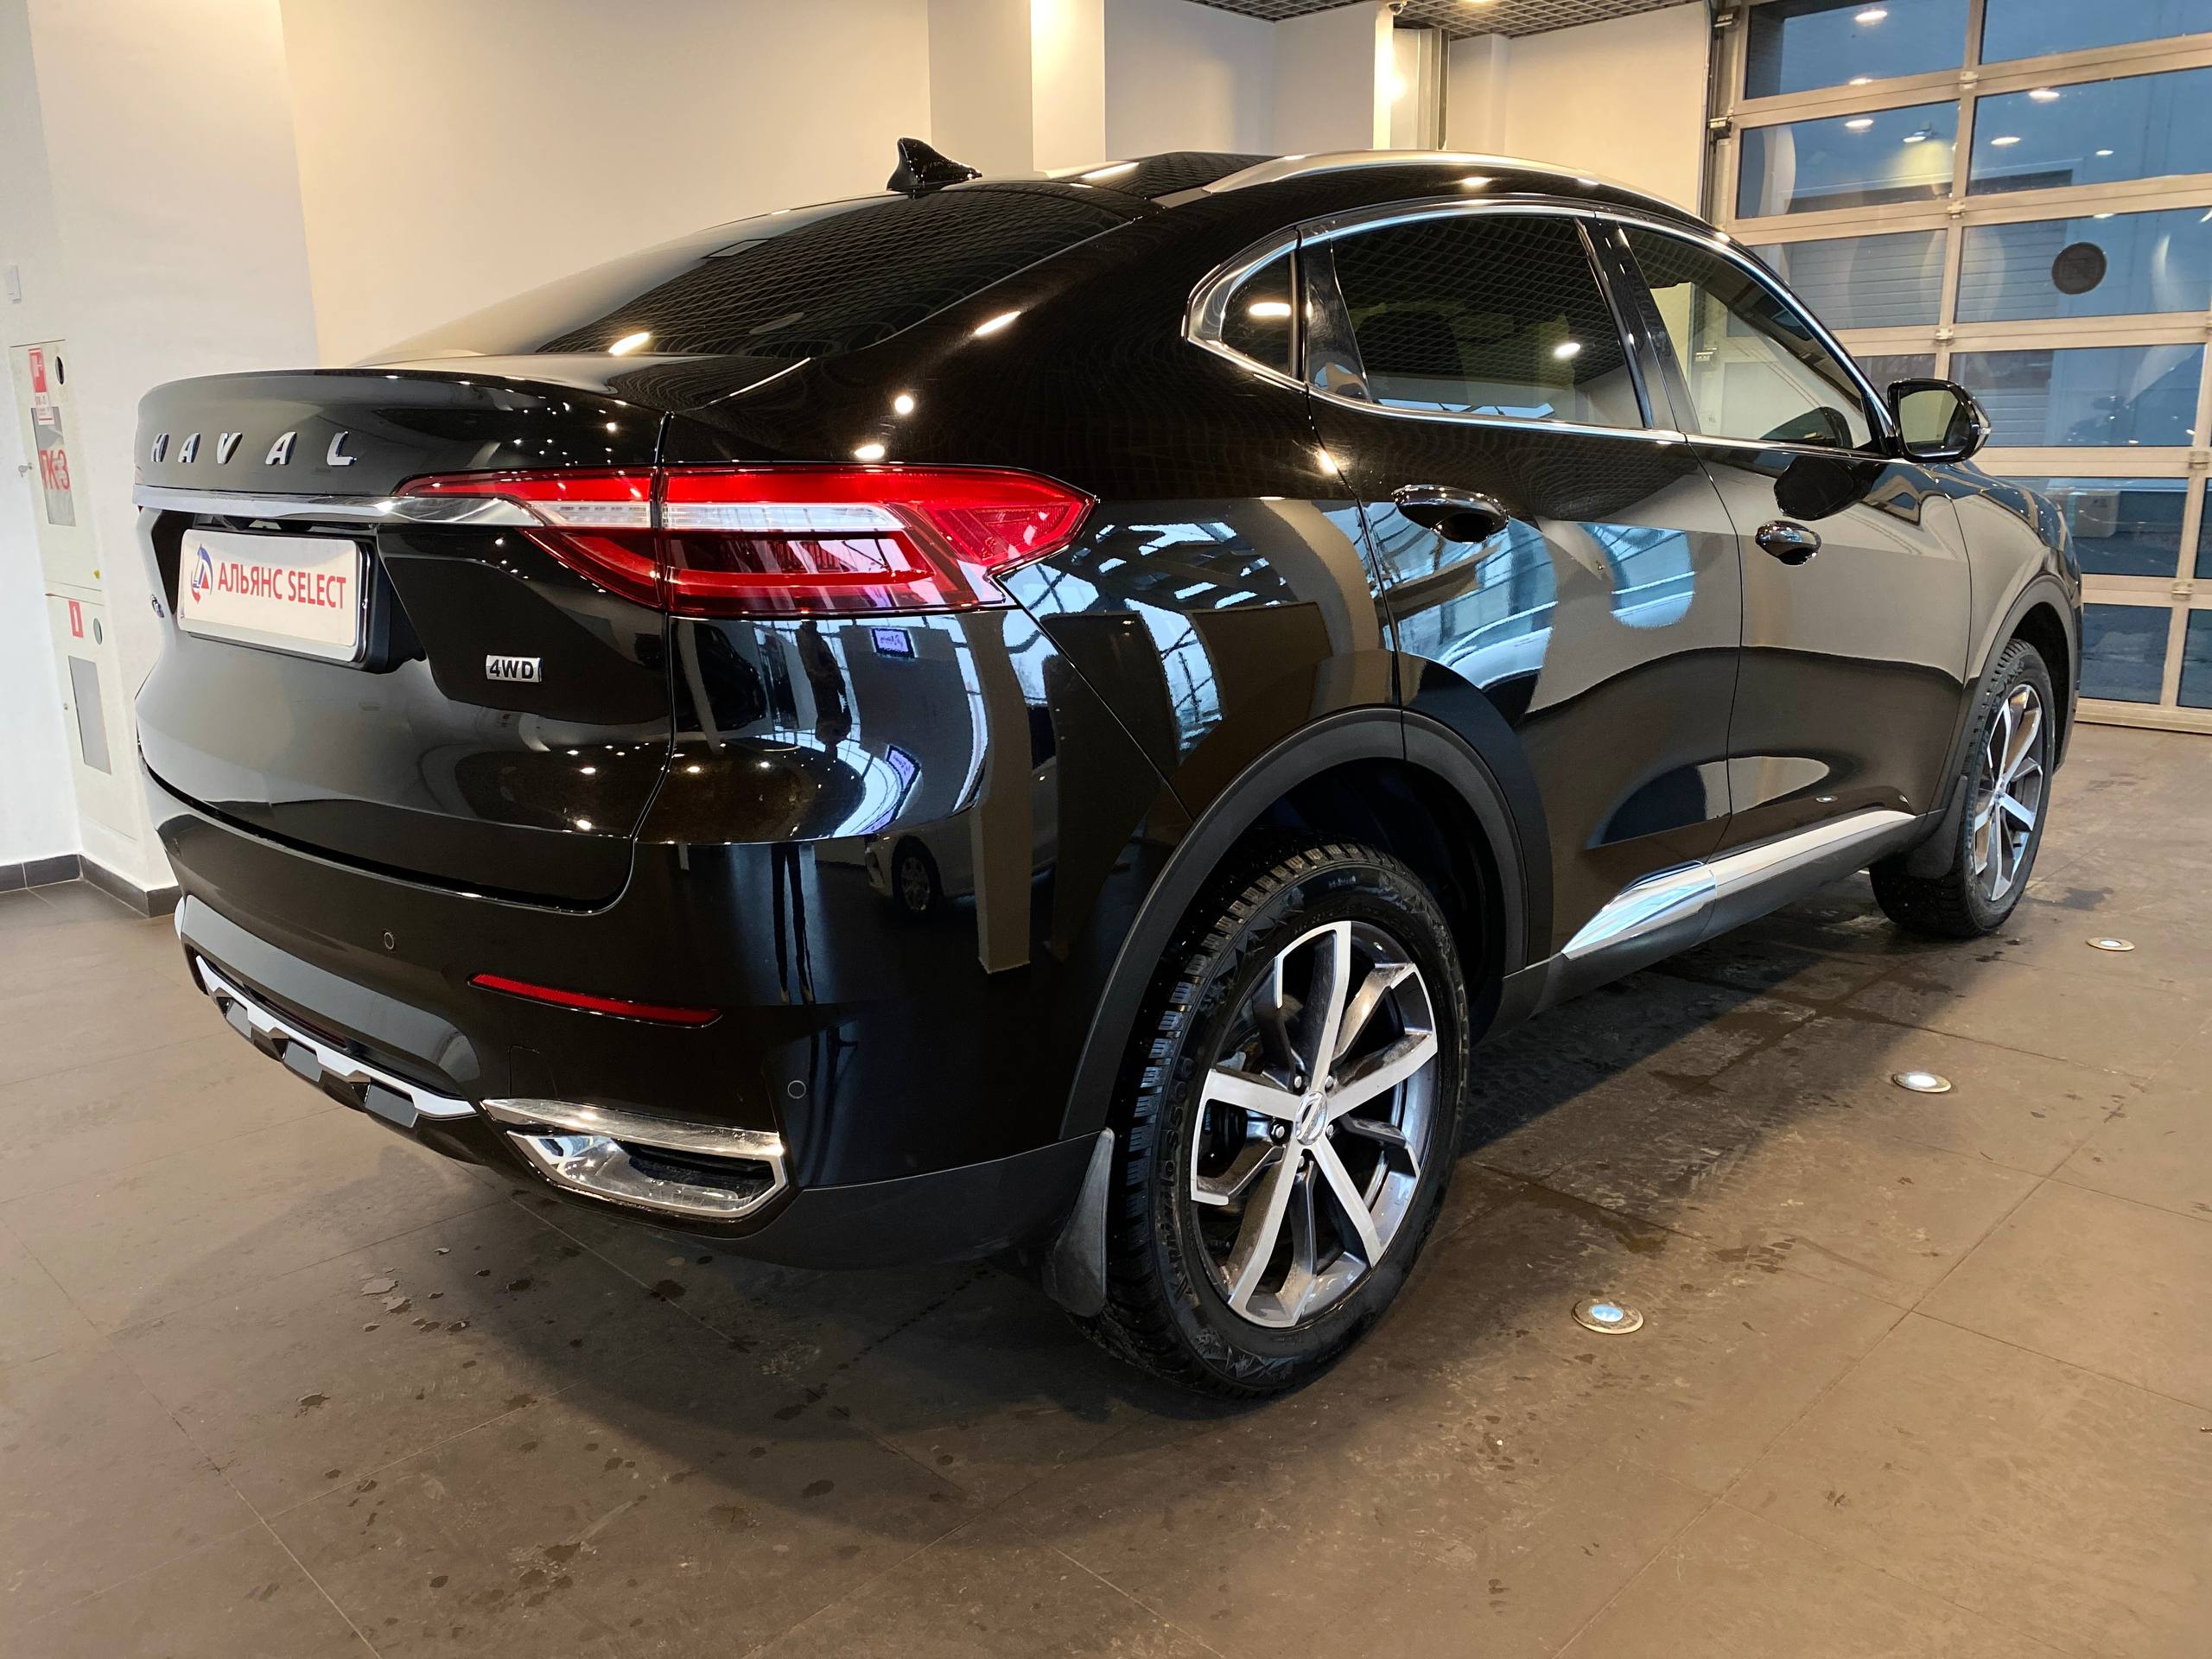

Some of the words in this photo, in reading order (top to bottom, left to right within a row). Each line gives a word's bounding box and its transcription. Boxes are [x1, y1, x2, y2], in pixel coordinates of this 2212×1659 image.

[150, 430, 358, 467] HAVAL
[218, 562, 283, 600] АЛЬЯНС
[288, 569, 346, 609] SELECT
[489, 658, 534, 679] 4WD
